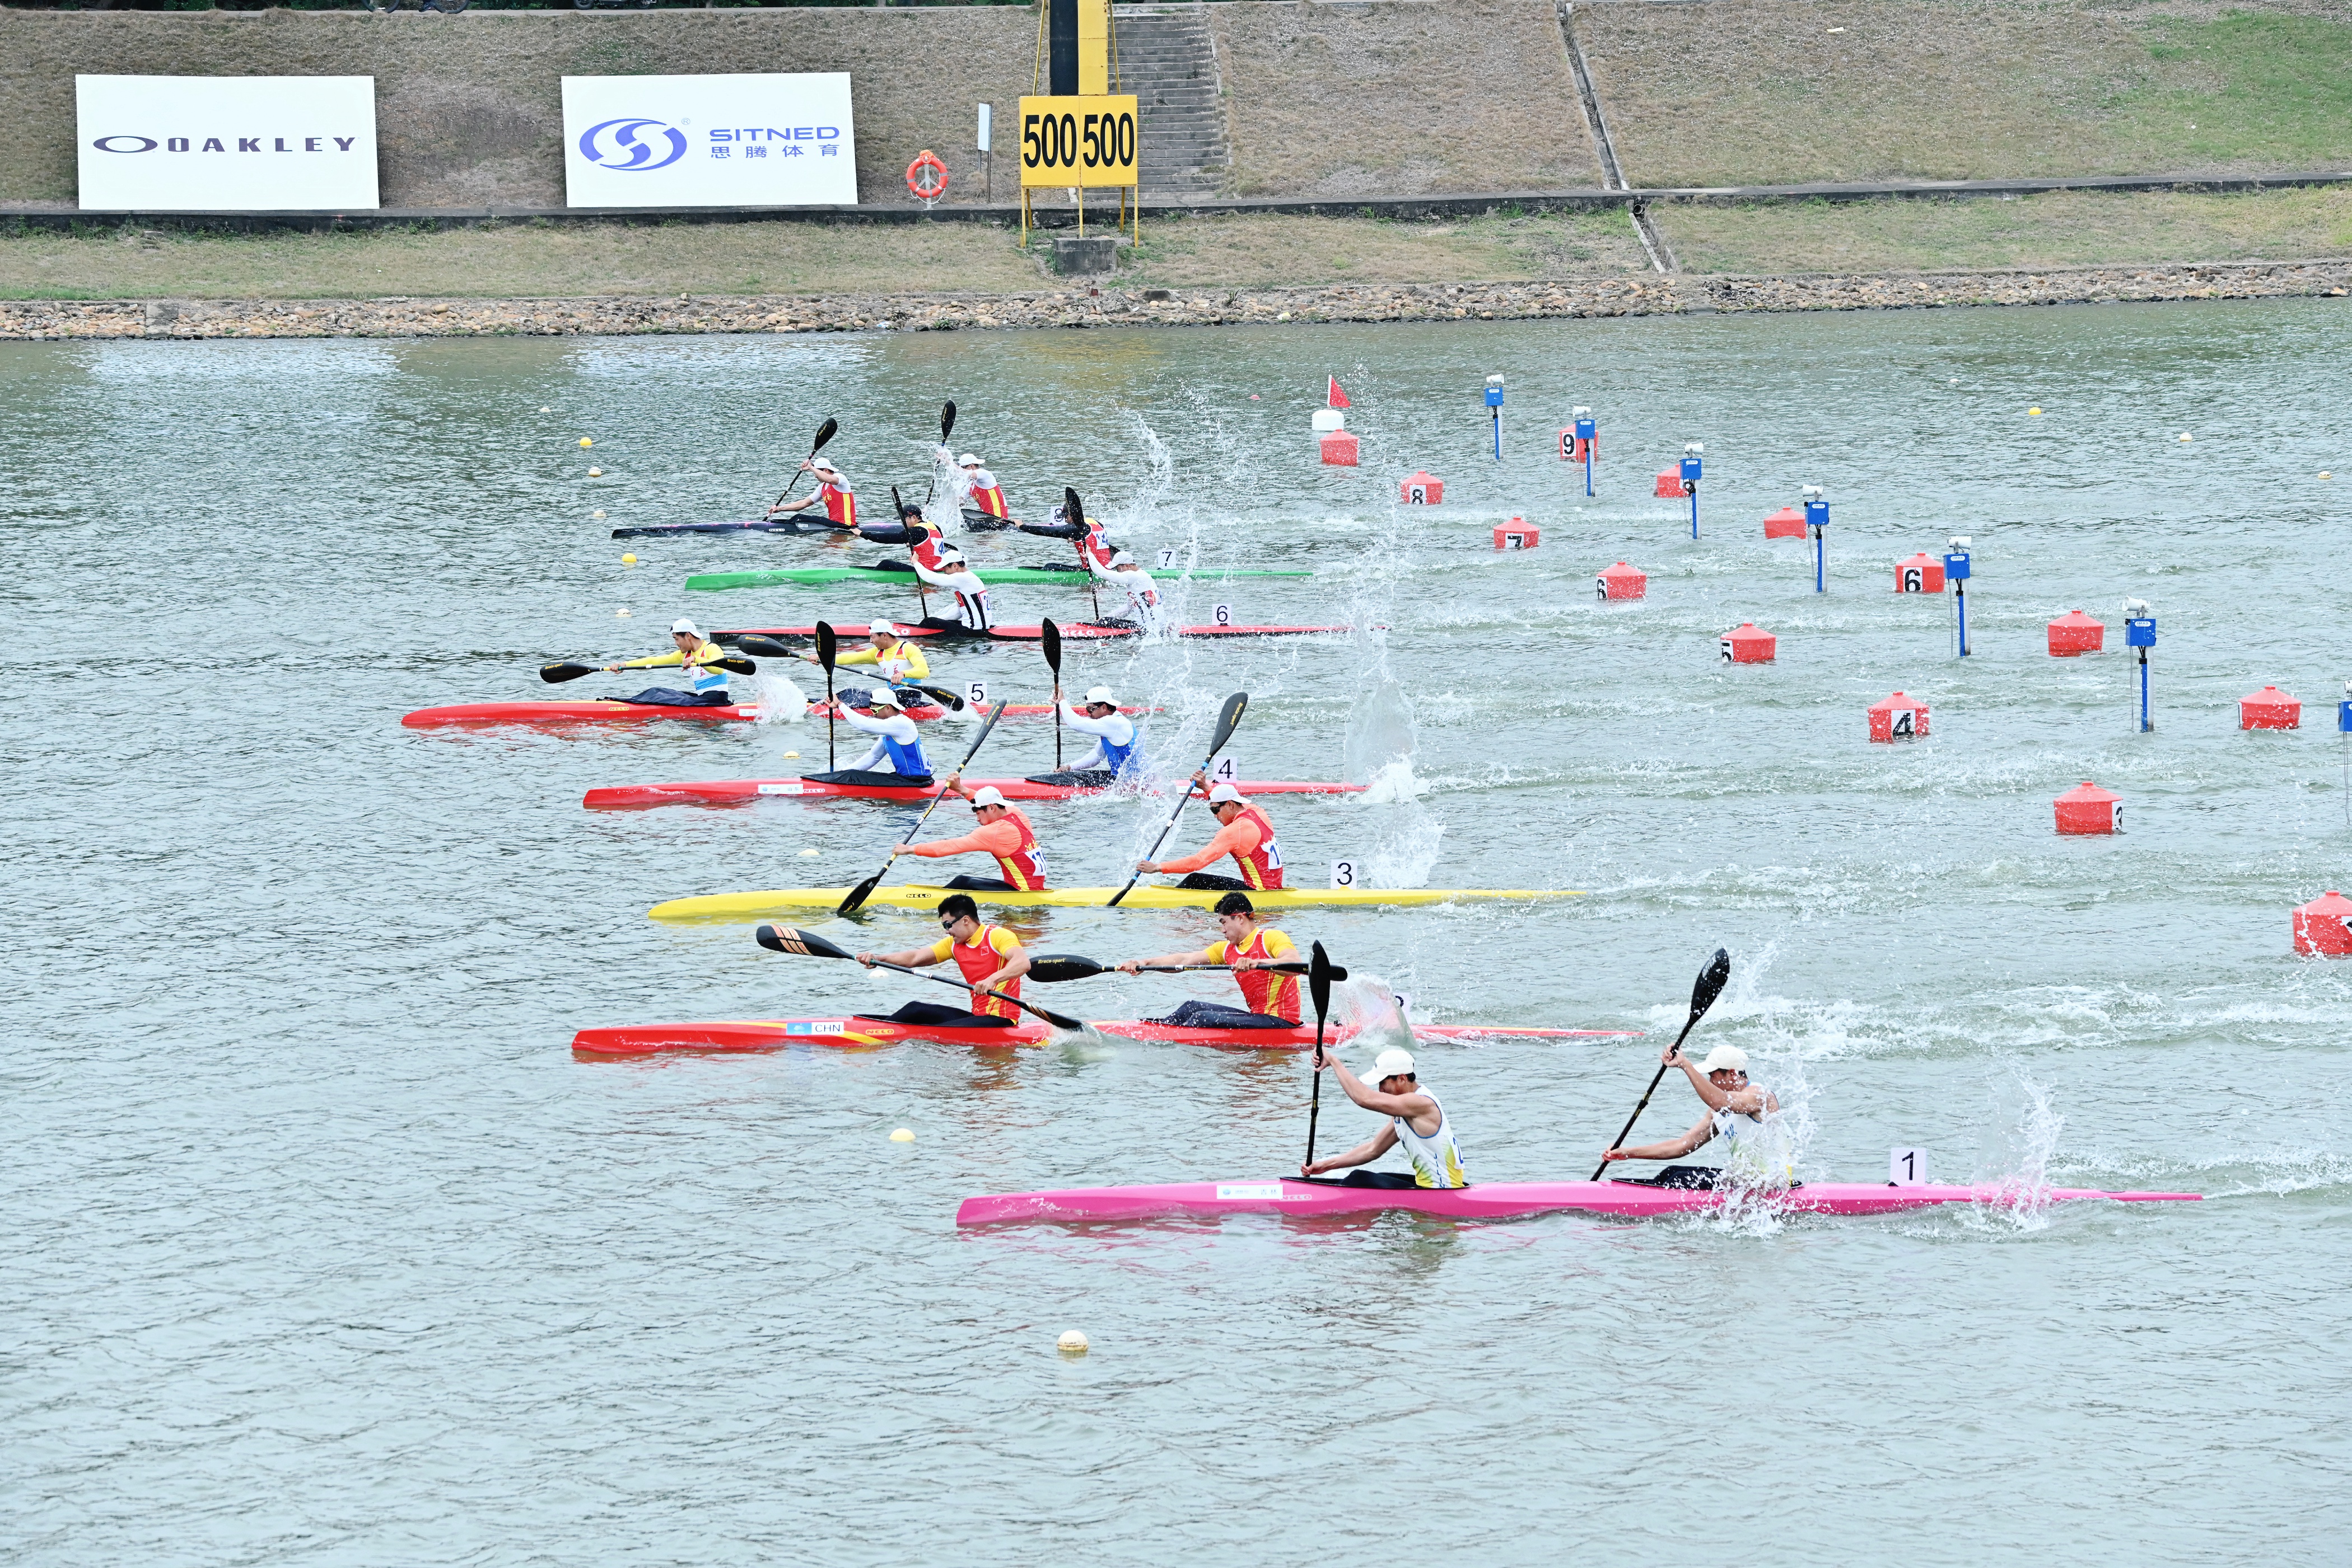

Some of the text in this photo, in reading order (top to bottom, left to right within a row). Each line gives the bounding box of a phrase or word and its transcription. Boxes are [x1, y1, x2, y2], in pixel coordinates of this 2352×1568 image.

[168, 137, 356, 152] OAKLEY
[710, 127, 840, 142] SITNED
[1023, 113, 1135, 168] 500 500
[711, 143, 840, 159] 思腾体育
[1563, 433, 1575, 455] 9
[1412, 489, 1423, 505] 8
[1508, 536, 1522, 548] 7
[1162, 551, 1173, 567] 7
[1597, 579, 1607, 600] 6
[1905, 569, 1921, 592] 6
[1216, 605, 1228, 622] 6
[1721, 642, 1732, 662] 5
[970, 684, 984, 702] 5
[1892, 712, 1914, 736] 4
[1218, 759, 1233, 779] 4
[1337, 862, 1352, 885] 3
[1901, 1151, 1915, 1181] 1
